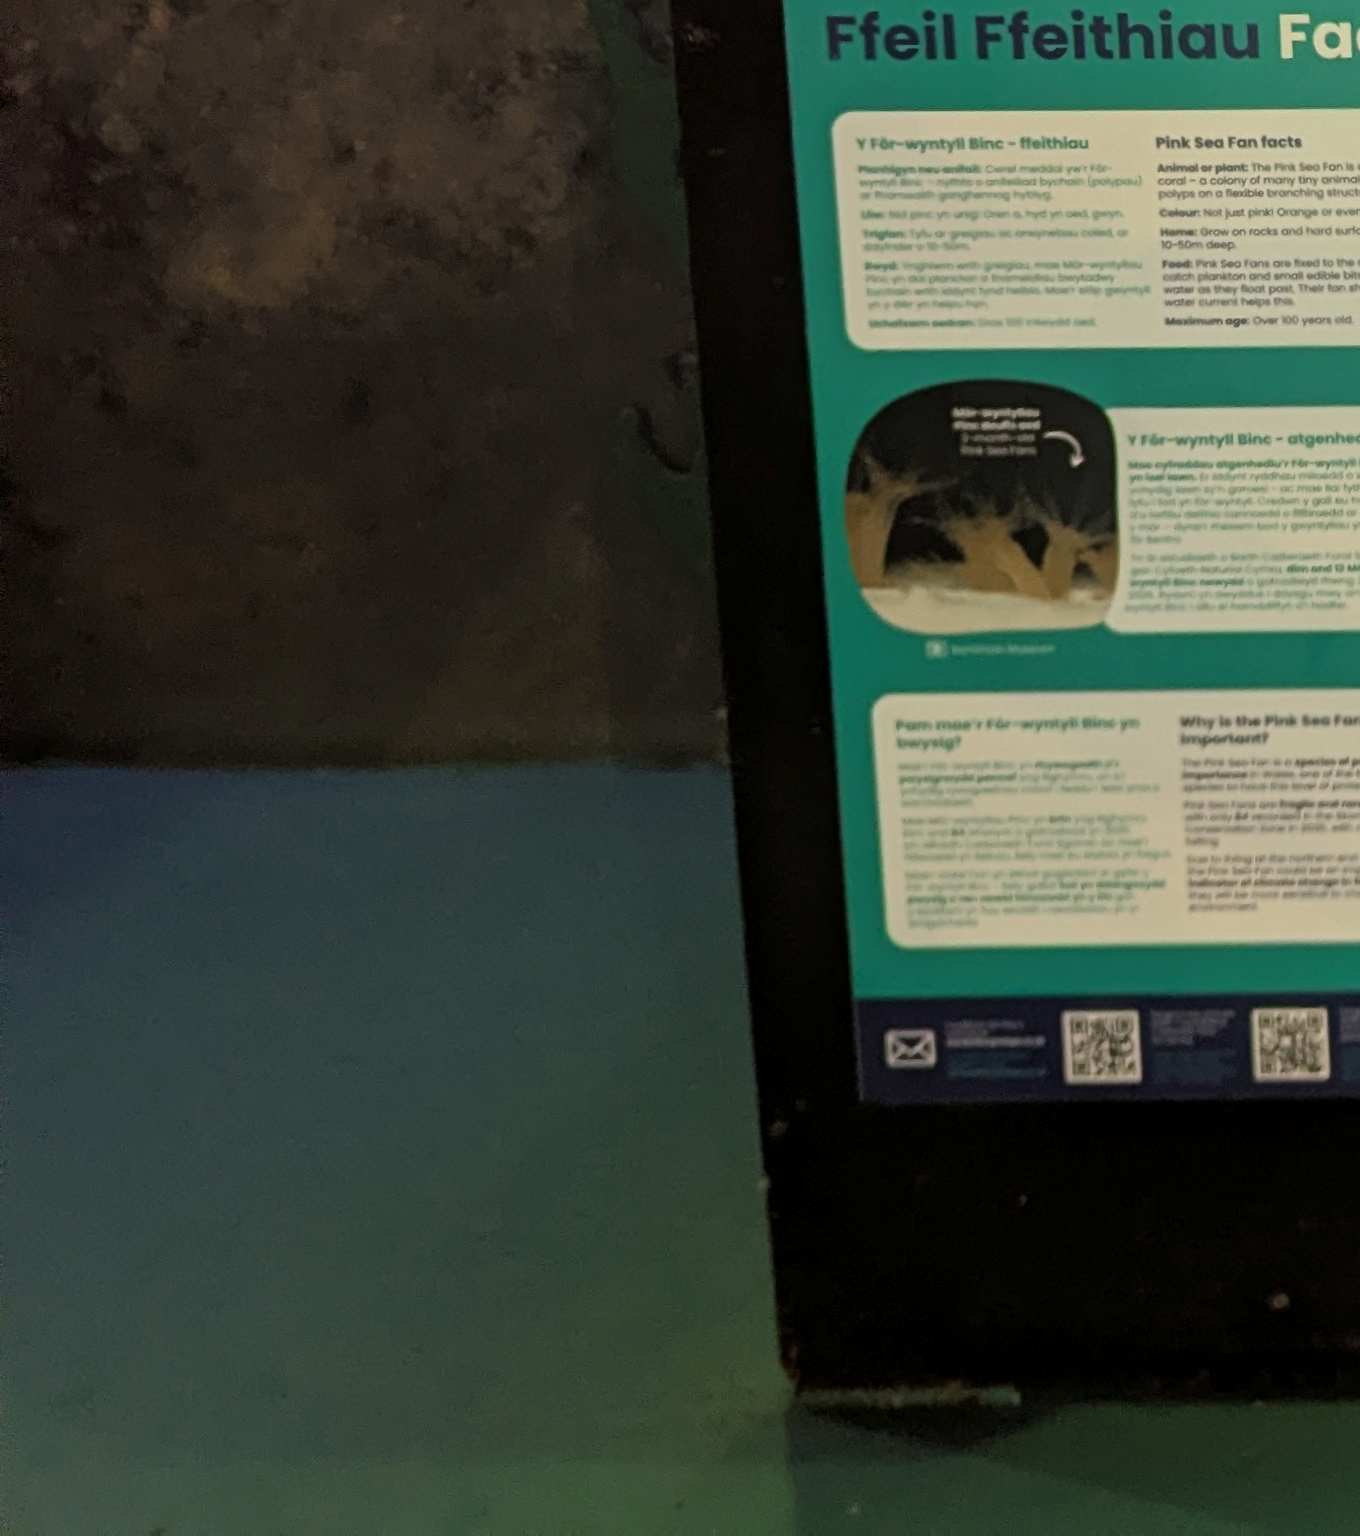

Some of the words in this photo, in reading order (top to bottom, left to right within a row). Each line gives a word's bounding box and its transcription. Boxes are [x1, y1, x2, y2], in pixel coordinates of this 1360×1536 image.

[826, 10, 956, 60] Ffeil
[975, 9, 1259, 60] Ffeithiau
[1156, 137, 1190, 148] Pink
[1194, 137, 1224, 148] Sea
[1228, 136, 1257, 147] Fan
[1260, 135, 1301, 148] facts
